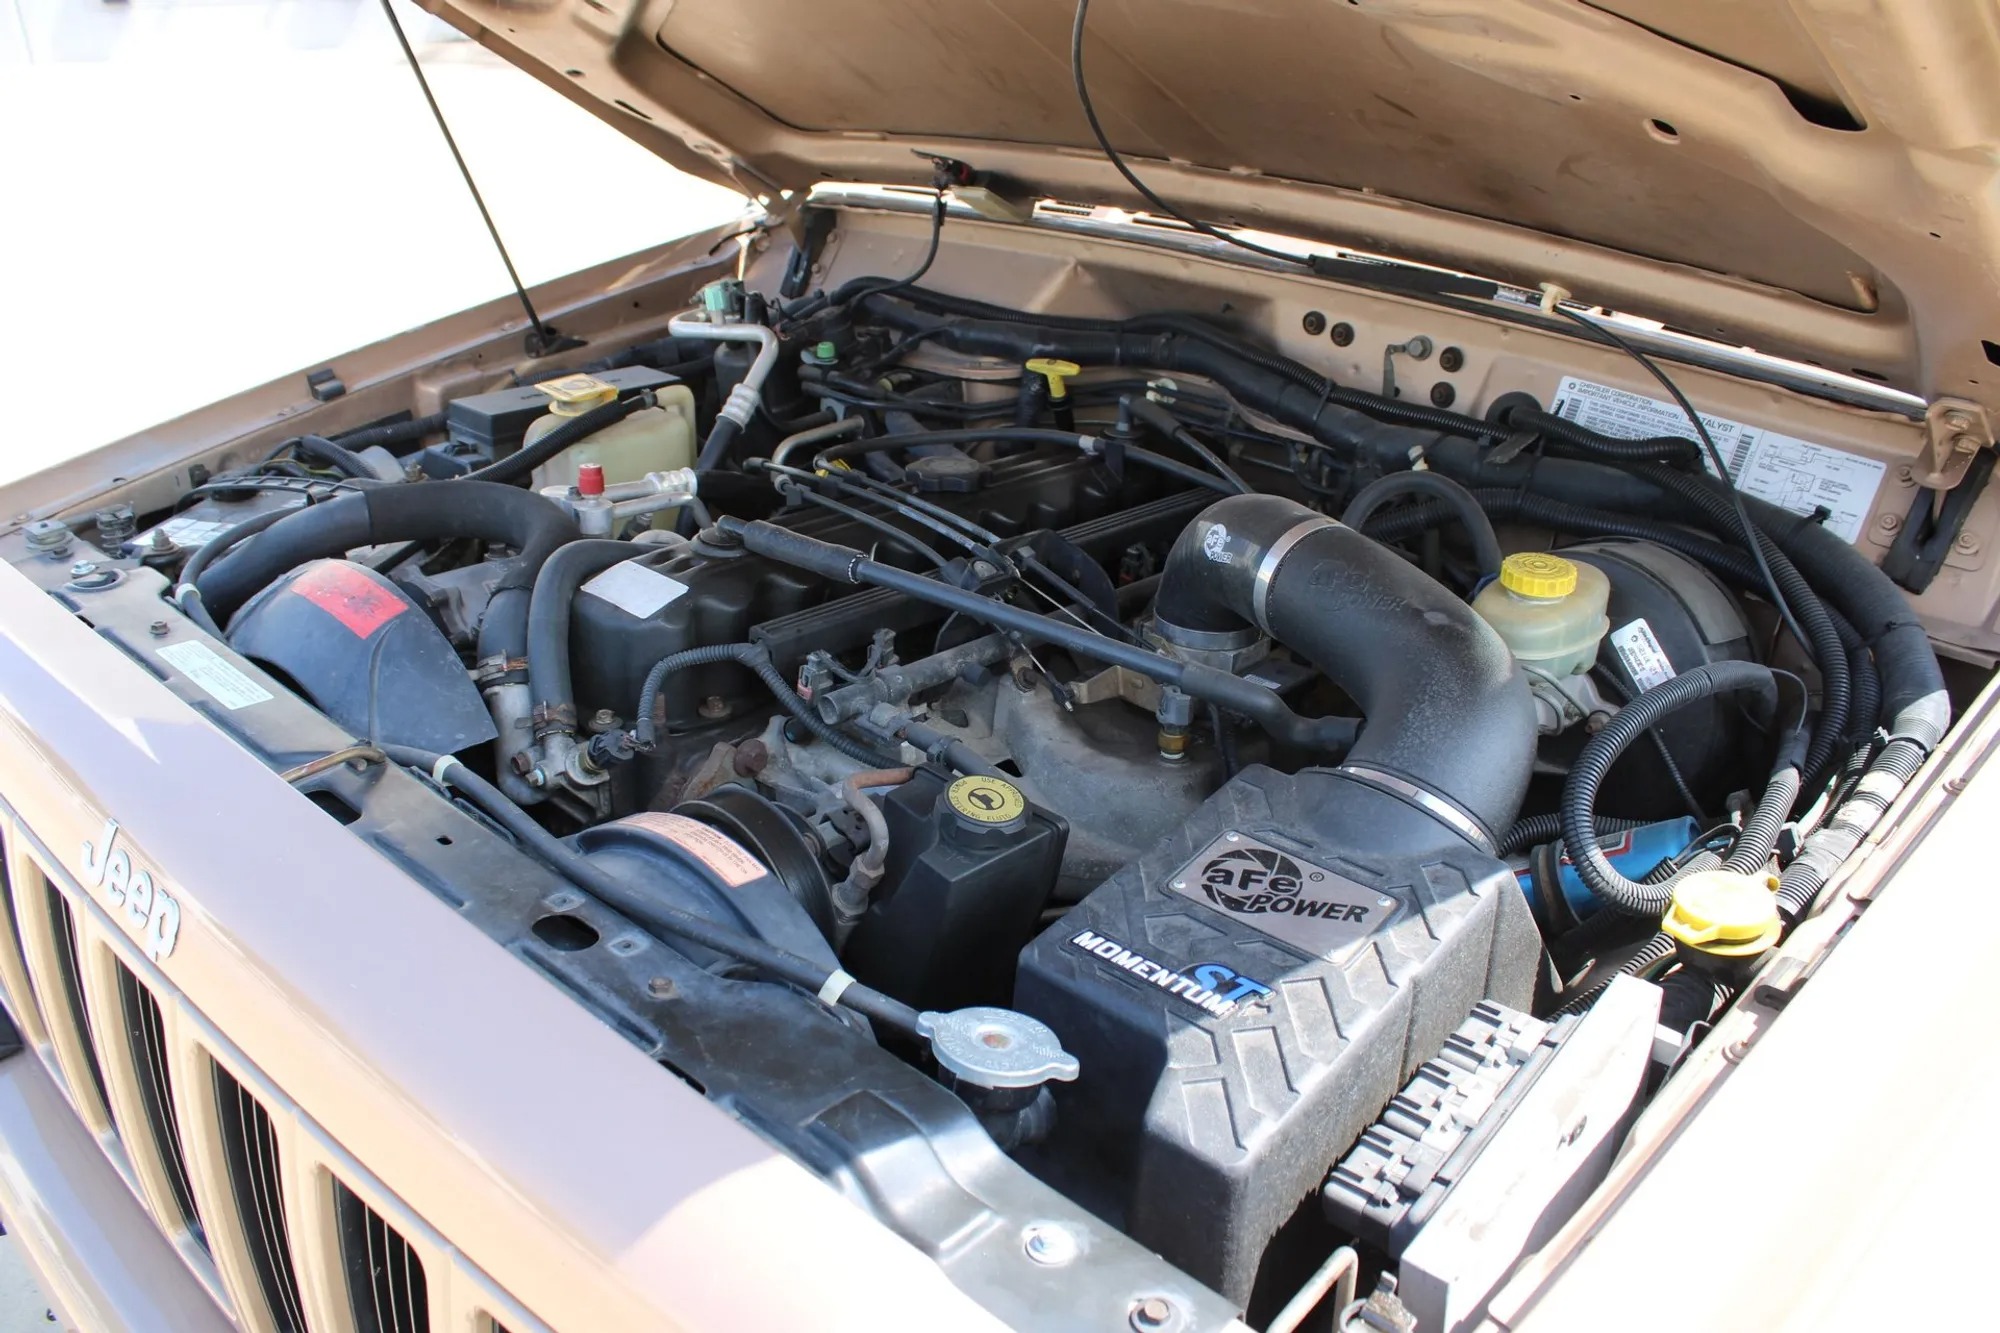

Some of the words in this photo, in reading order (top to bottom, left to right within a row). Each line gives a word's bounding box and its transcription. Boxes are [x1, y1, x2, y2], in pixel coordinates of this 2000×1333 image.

[1577, 387, 1612, 401] IMPORTANT
[1613, 396, 1636, 408] VEHICLE
[1637, 401, 1680, 420] INFORMATION
[1579, 381, 1611, 394] CHRYSLER
[1611, 388, 1653, 406] CORPORATION
[80, 817, 181, 963] Jeep
[1206, 867, 1298, 894] aFe
[1244, 894, 1370, 923] POWER
[1072, 930, 1237, 1017] MOMENTUM
[1194, 964, 1273, 1003] ST
